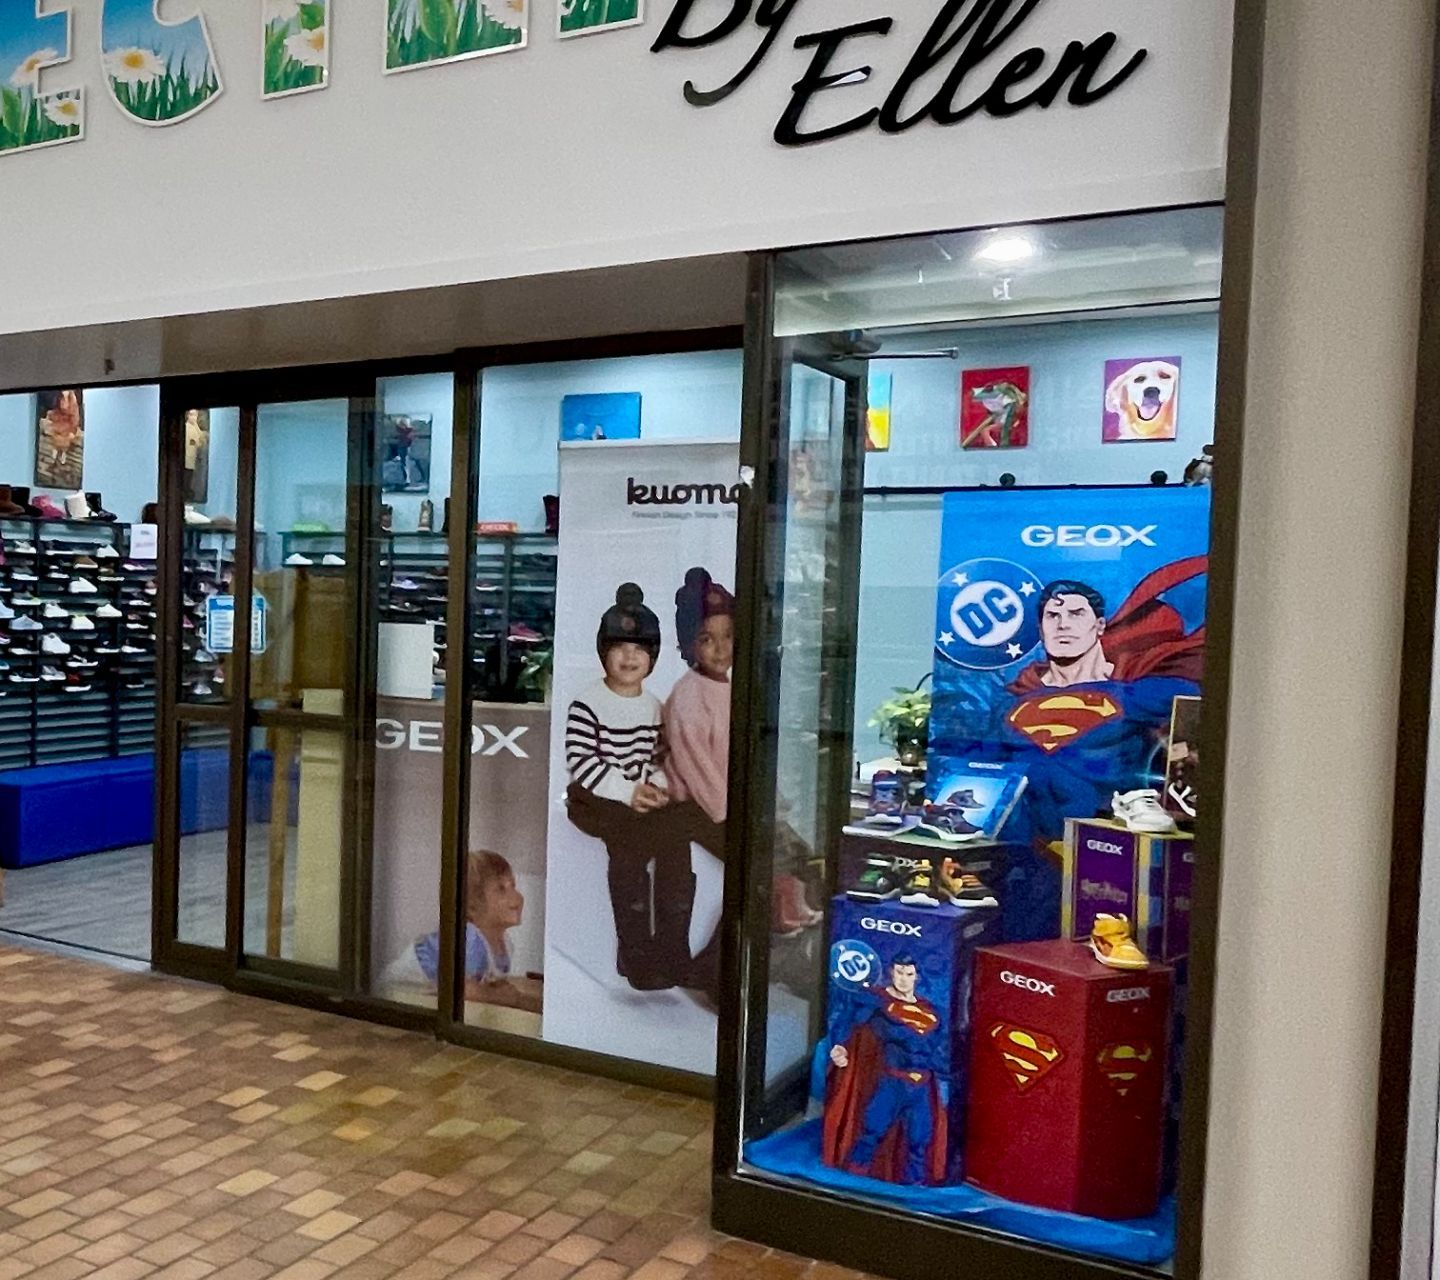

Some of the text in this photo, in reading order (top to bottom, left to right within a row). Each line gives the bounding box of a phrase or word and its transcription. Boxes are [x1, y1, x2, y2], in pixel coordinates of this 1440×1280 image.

[1020, 524, 1158, 548] GEOX
[957, 587, 1018, 639] DC
[1086, 839, 1123, 856] GEOX
[861, 917, 923, 938] GEOX
[840, 953, 867, 978] DC
[999, 970, 1057, 998] GEOX
[1105, 986, 1152, 1004] GEOX
